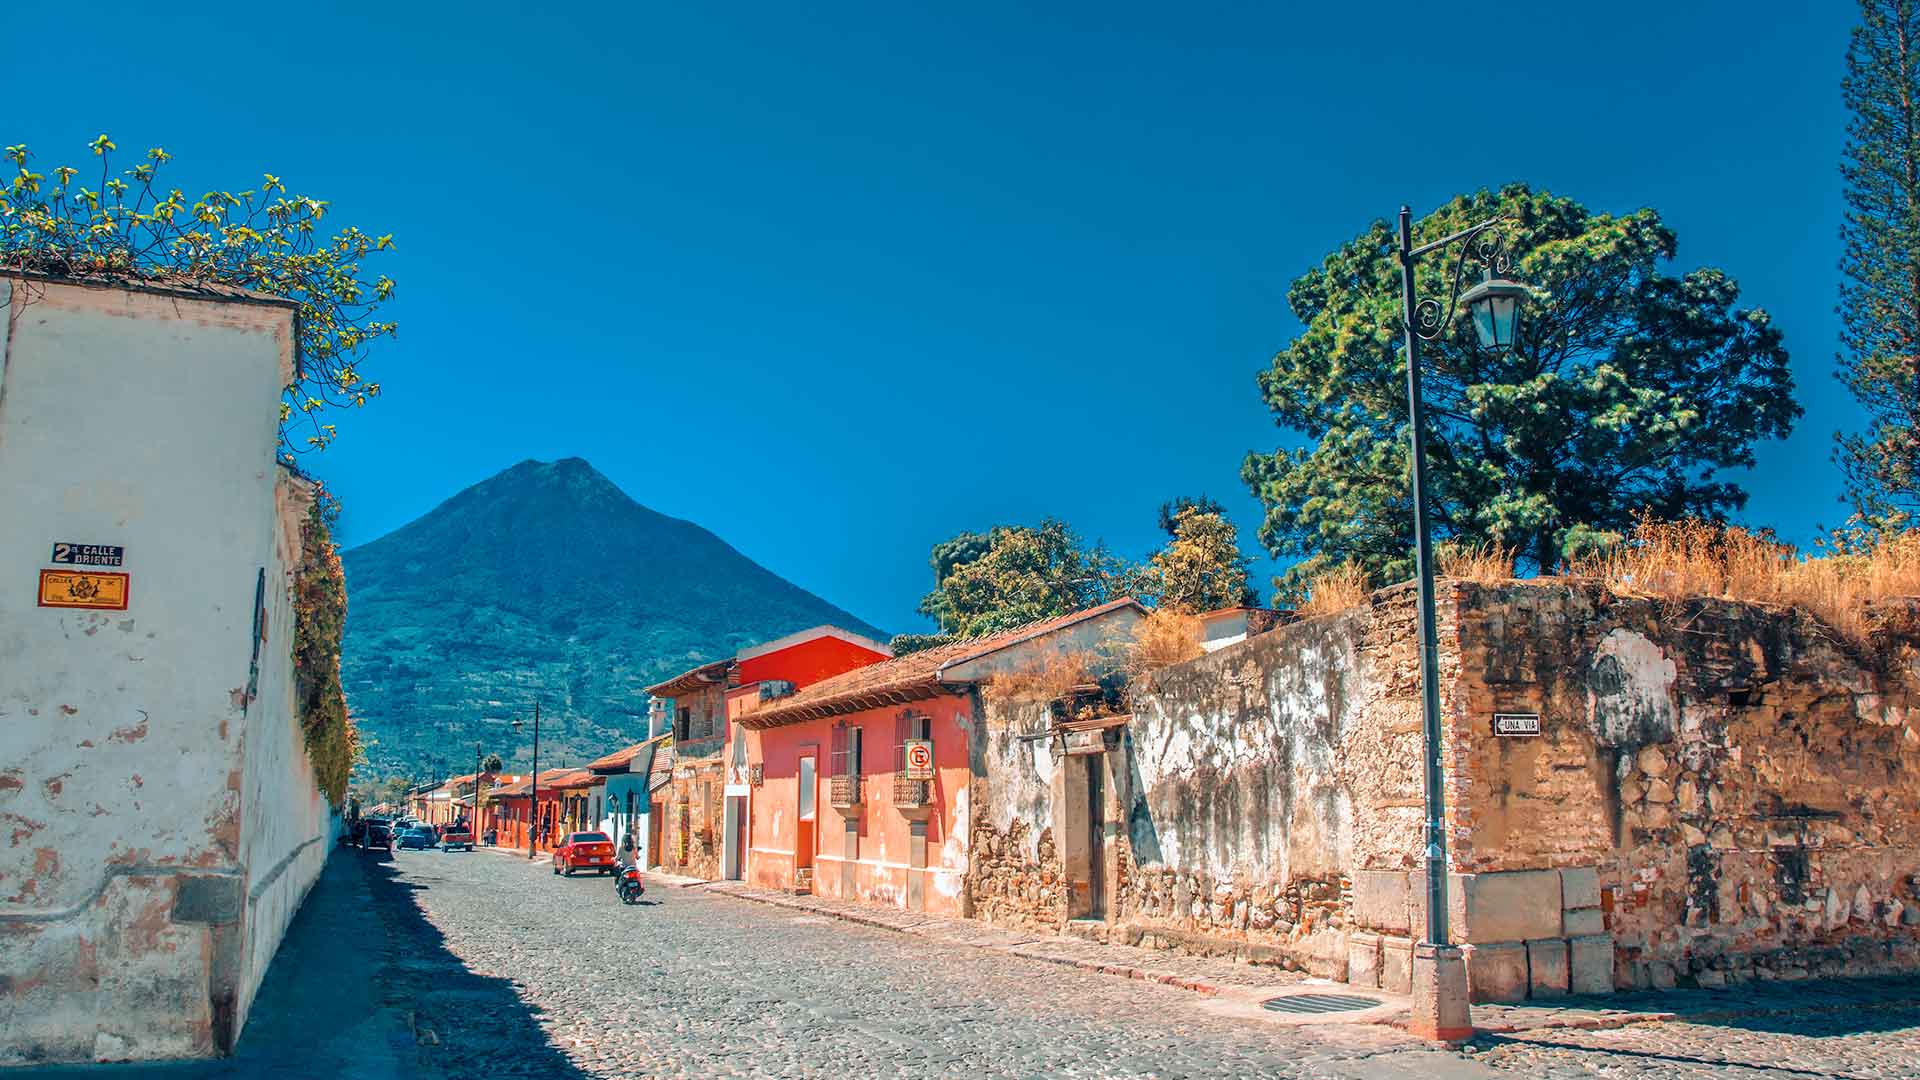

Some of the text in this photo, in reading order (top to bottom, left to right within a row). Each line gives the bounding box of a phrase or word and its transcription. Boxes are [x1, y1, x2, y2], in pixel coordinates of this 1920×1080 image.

[83, 546, 115, 555] CALLE
[75, 555, 121, 565] ORIENTE
[1504, 720, 1536, 729] UNA VIA
